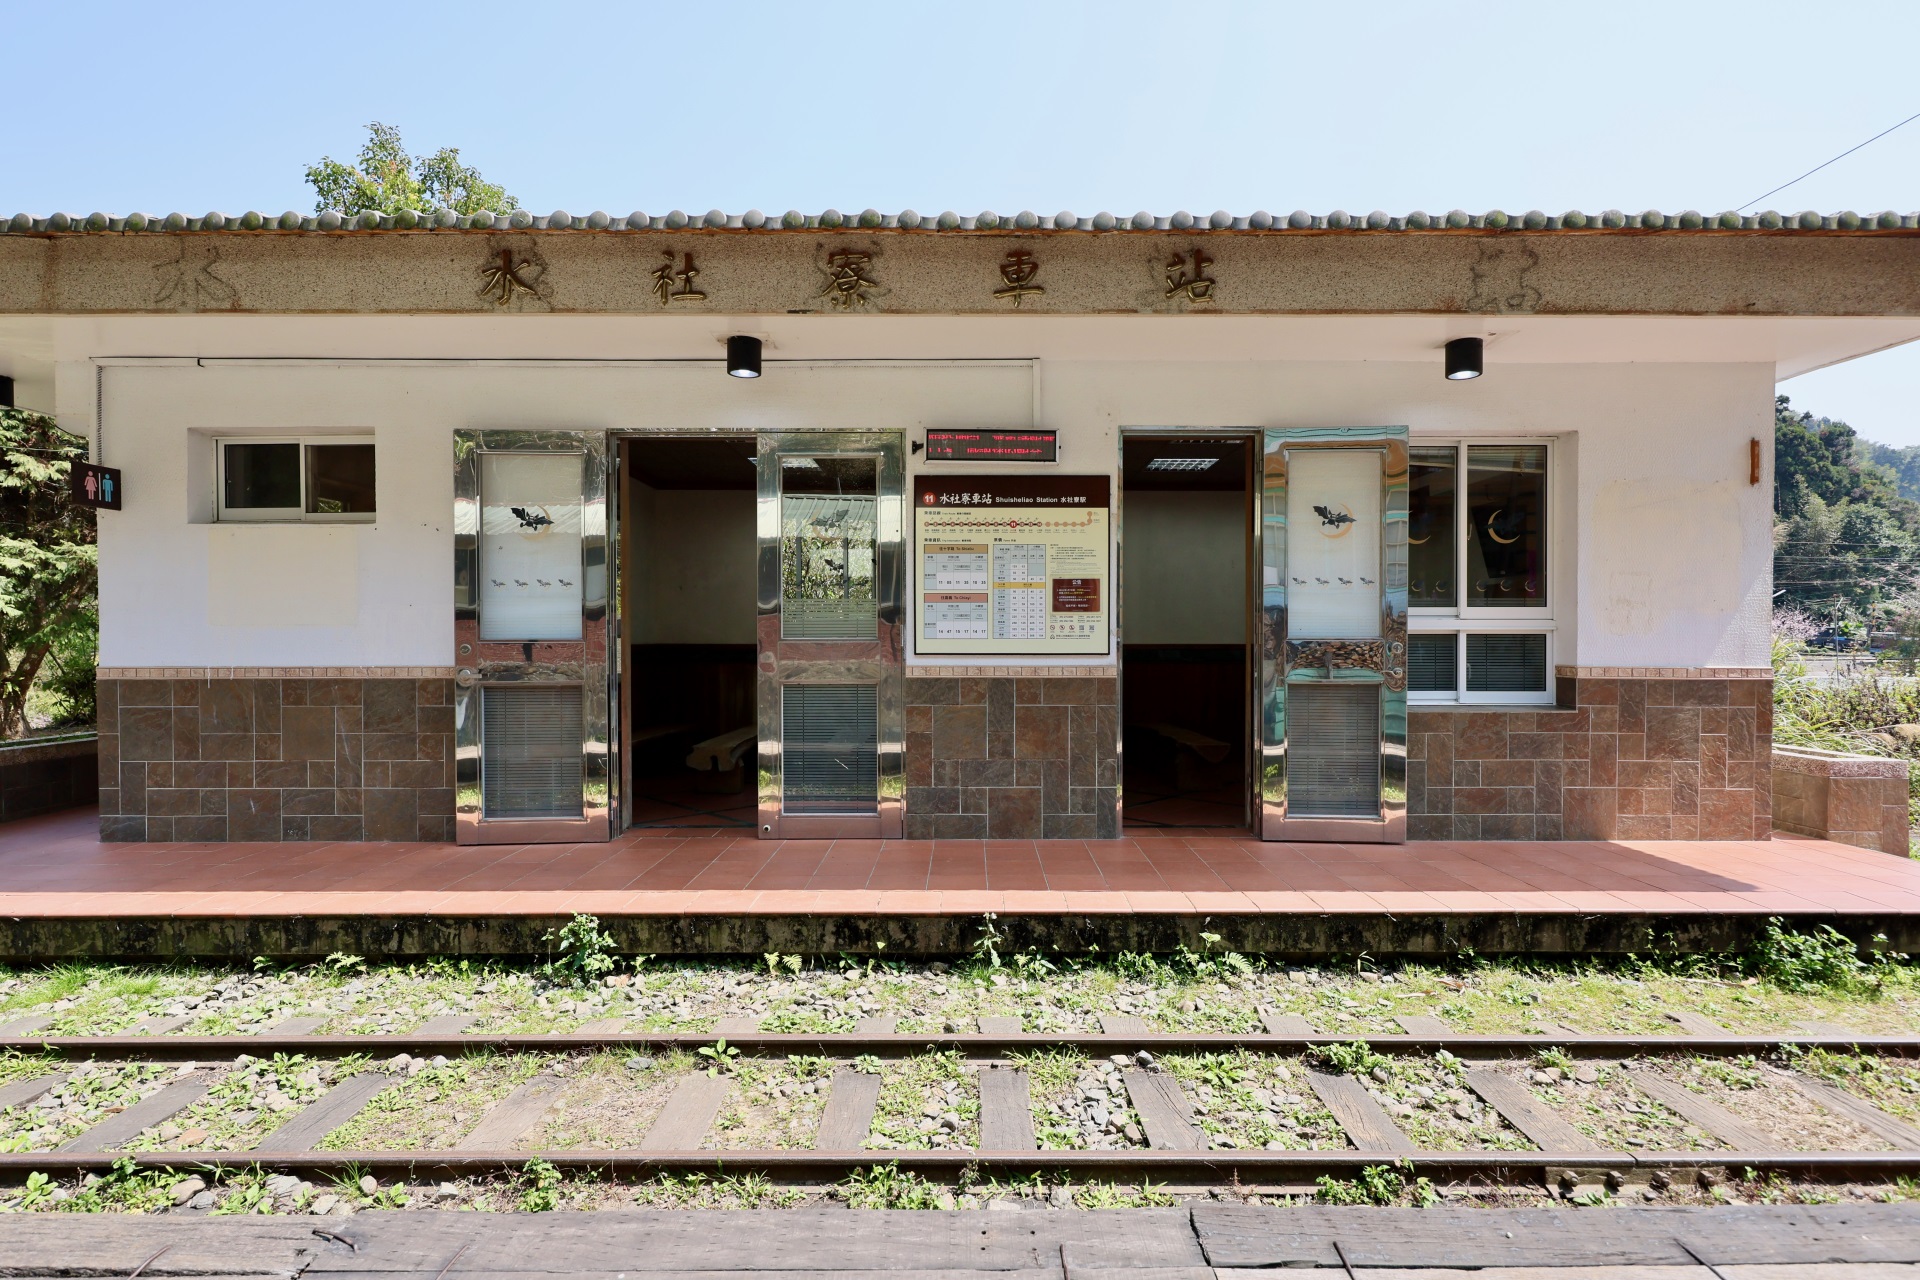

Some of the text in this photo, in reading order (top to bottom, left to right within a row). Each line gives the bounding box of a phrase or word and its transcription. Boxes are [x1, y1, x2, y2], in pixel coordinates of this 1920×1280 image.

[481, 248, 1217, 308] 水社寮車站
[924, 494, 934, 503] 11
[939, 492, 992, 505] 水社寮車站
